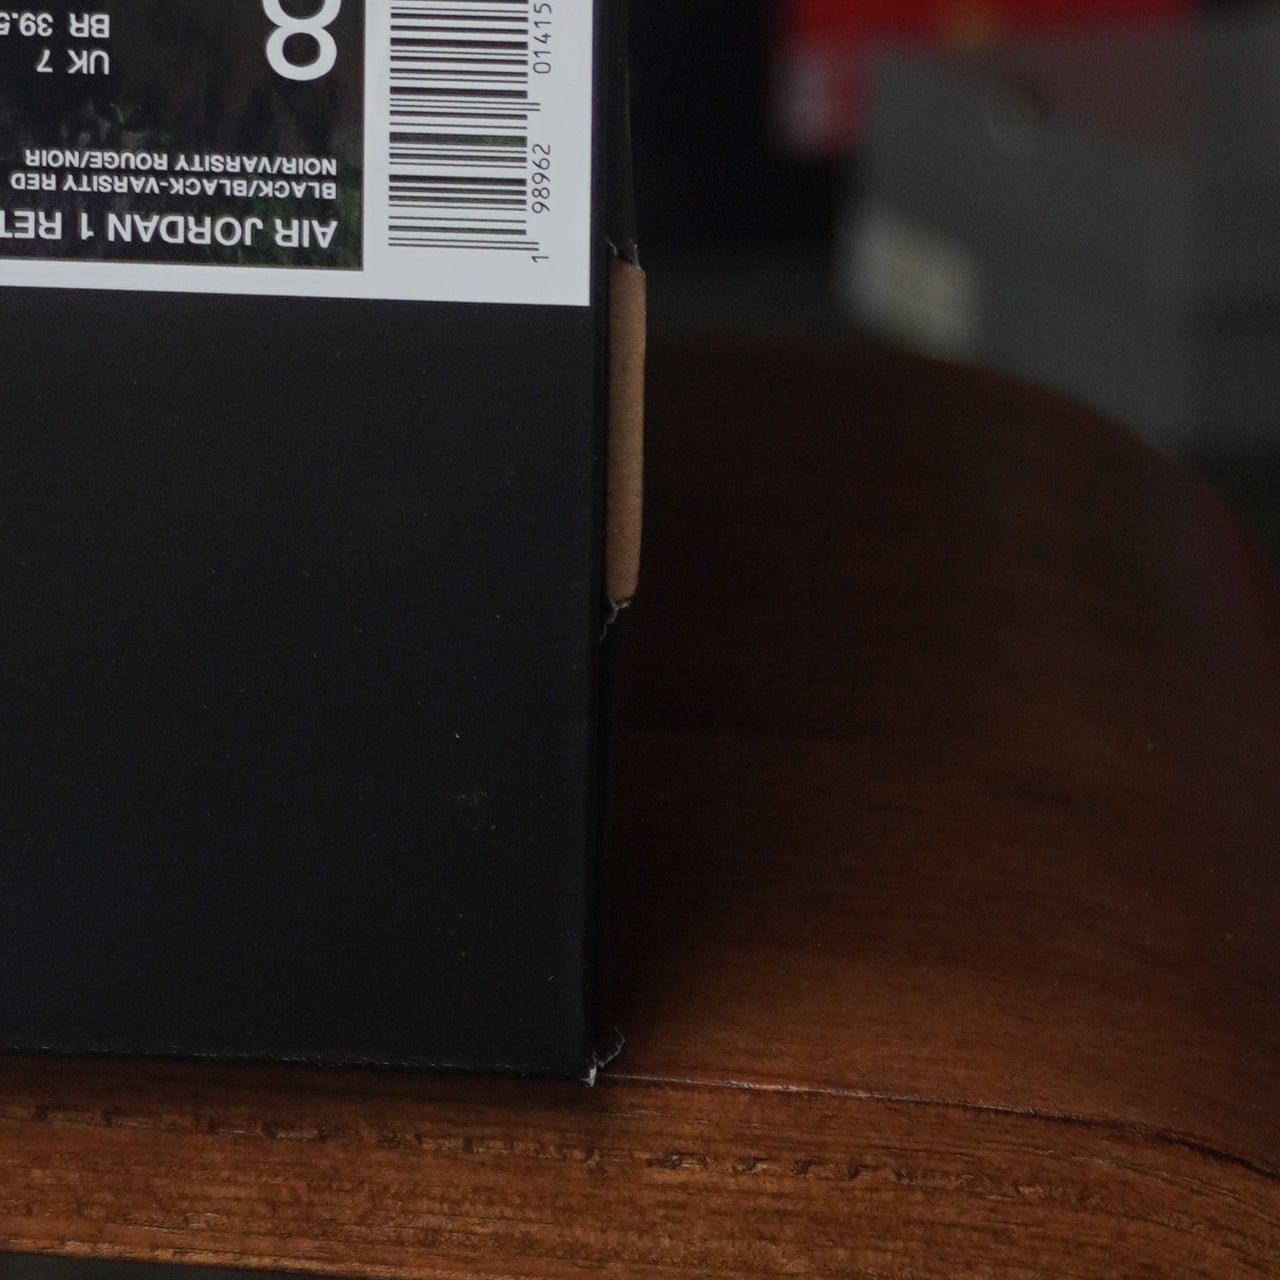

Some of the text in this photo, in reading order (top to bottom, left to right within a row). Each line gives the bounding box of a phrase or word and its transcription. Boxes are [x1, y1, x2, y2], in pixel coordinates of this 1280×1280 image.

[70, 13, 109, 38] BR
[533, 3, 552, 74] 01415
[37, 49, 53, 72] 7
[68, 50, 109, 74] UK
[26, 150, 336, 175] NOIR/VARSITY ROUGE/NOIR
[11, 173, 336, 199] BLACK/BLACK-VARSITY RED
[532, 144, 550, 214] 98962
[81, 213, 94, 240] 1
[108, 214, 263, 246] JORDAN
[275, 219, 338, 248] AIR
[531, 253, 549, 263] 1
